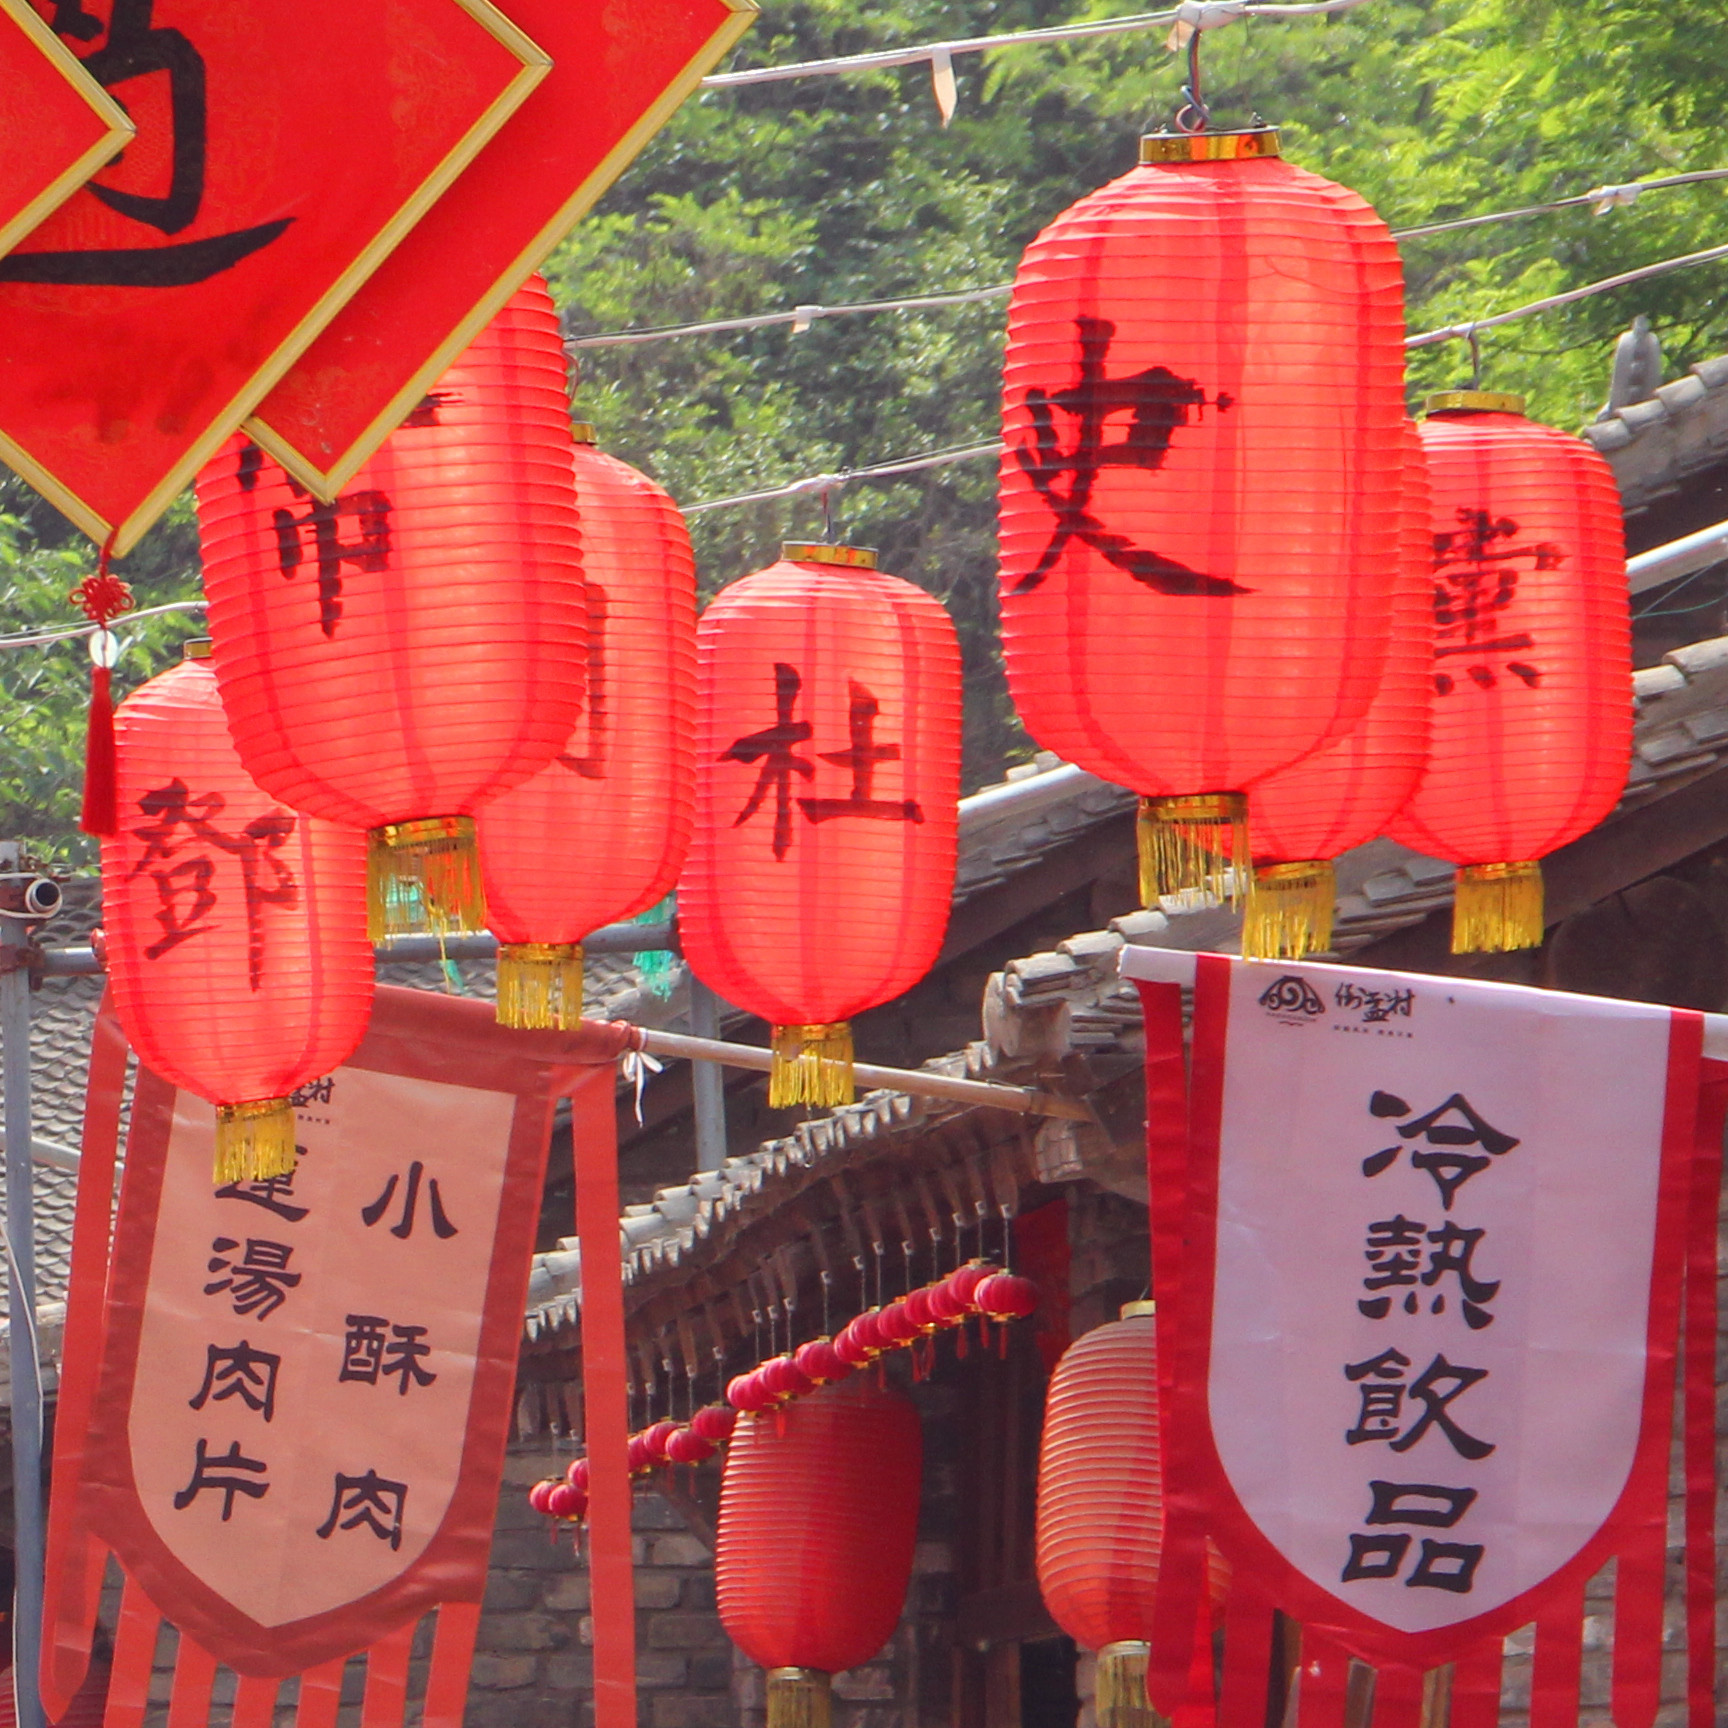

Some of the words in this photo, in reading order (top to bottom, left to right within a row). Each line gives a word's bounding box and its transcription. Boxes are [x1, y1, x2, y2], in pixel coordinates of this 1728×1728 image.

[1008, 316, 1260, 597] 史
[124, 776, 300, 994] 鄧
[716, 661, 925, 864] 杜
[315, 1160, 459, 1552] 小酥肉
[1340, 1089, 1521, 1594] 冷熱飲品
